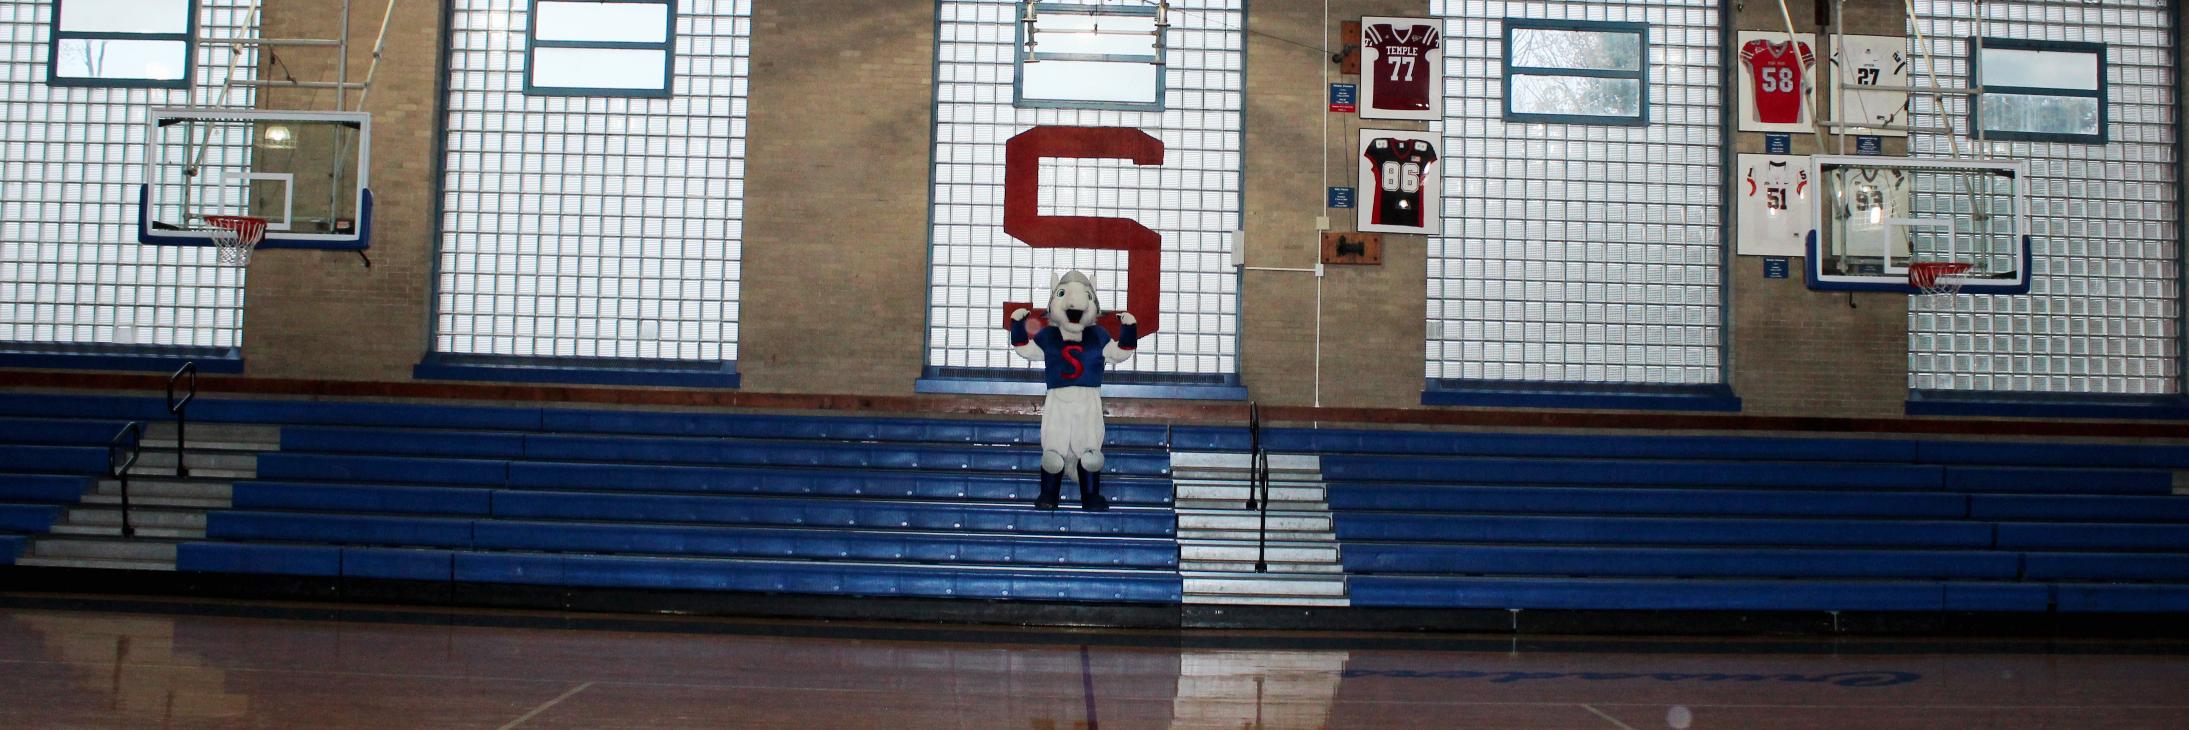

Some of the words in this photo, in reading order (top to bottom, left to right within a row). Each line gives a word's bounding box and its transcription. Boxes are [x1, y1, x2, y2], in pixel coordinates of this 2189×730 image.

[1386, 45, 1418, 56] TEMPLE
[1388, 57, 1416, 82] 77
[1762, 66, 1794, 93] 58
[1857, 67, 1880, 86] 27
[1382, 160, 1419, 194] 86
[1767, 187, 1787, 210] 51
[1003, 125, 1164, 341] S
[1060, 345, 1086, 380] S
